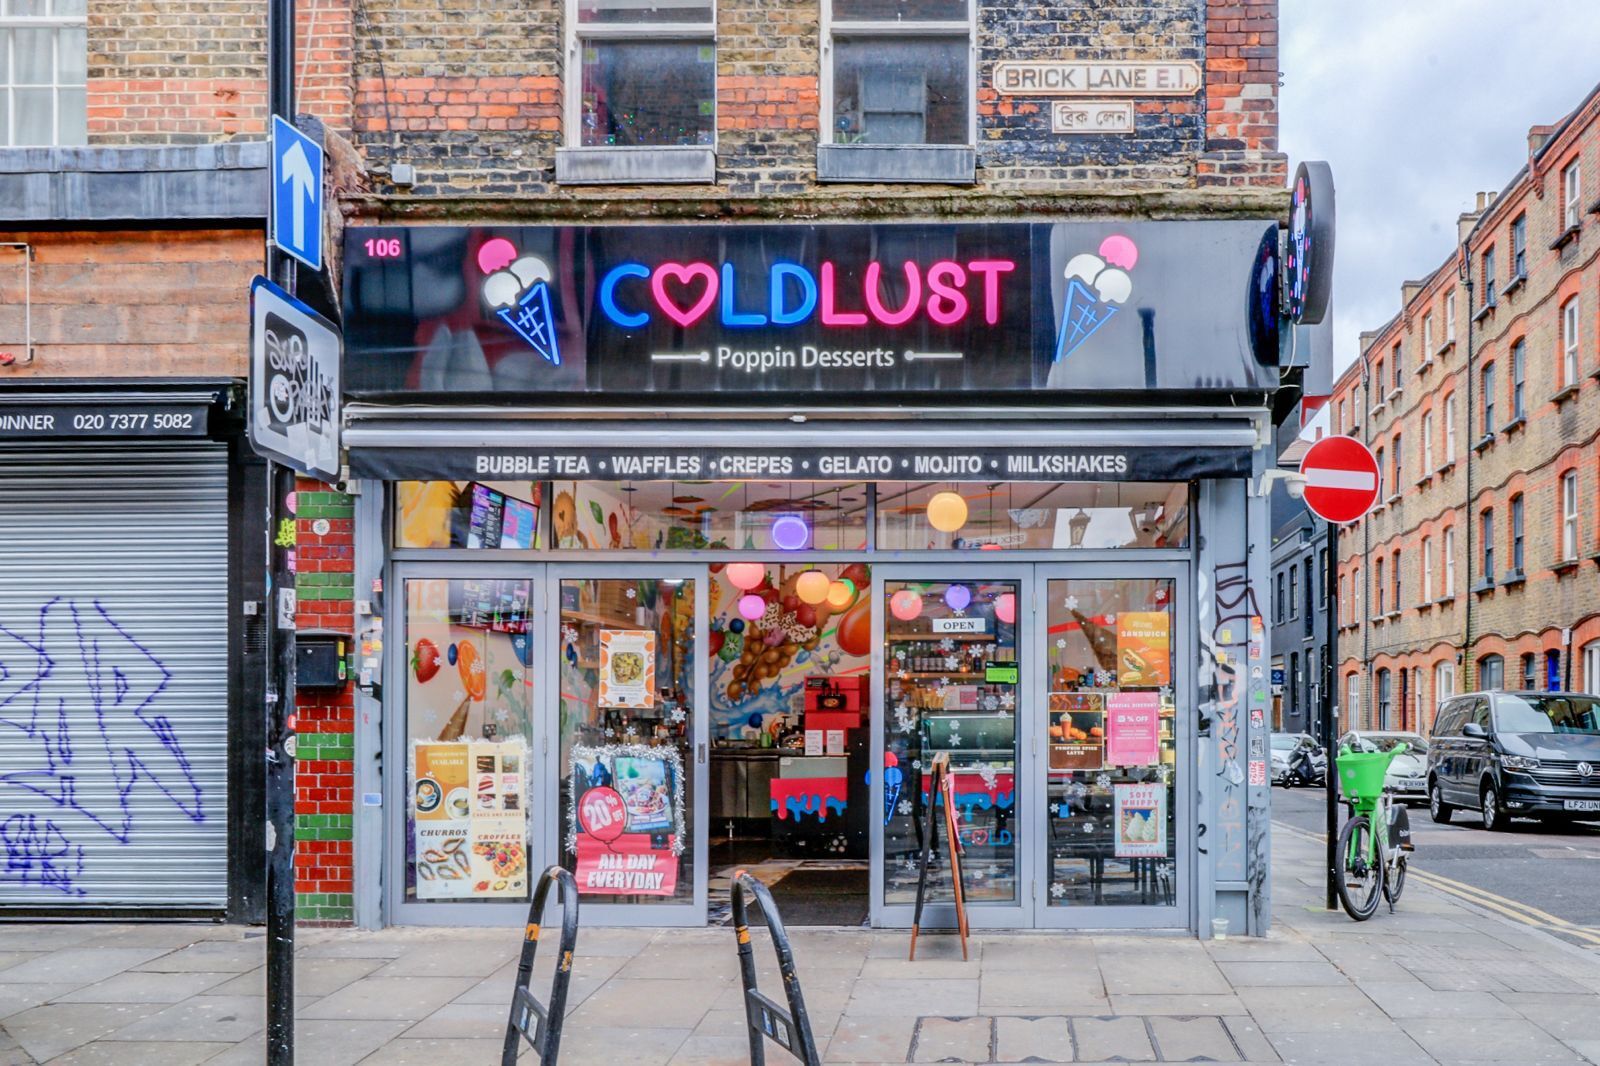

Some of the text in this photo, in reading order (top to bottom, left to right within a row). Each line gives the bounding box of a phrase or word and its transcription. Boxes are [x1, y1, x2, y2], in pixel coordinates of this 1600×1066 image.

[1005, 68, 1076, 89] BRICK
[1087, 67, 1147, 90] LANE
[1059, 105, 1127, 128] ব্রিক লেন
[364, 239, 401, 257] 106
[717, 346, 895, 372] Poppin Desserts
[73, 414, 105, 430] 020
[109, 413, 149, 430] 7377
[153, 413, 193, 429] 5082
[476, 455, 1127, 474] BUBBLE TEA WAFFLES CREPES GELATO MOJITO MILKSHAKES
[943, 621, 975, 630] OPEN
[1129, 791, 1153, 799] SOFT
[1568, 801, 1587, 809] LF21
[612, 809, 624, 823] OFF
[420, 829, 469, 837] CHURROS
[598, 854, 657, 871] ALL DAY
[587, 871, 665, 890] EVERYDAY
